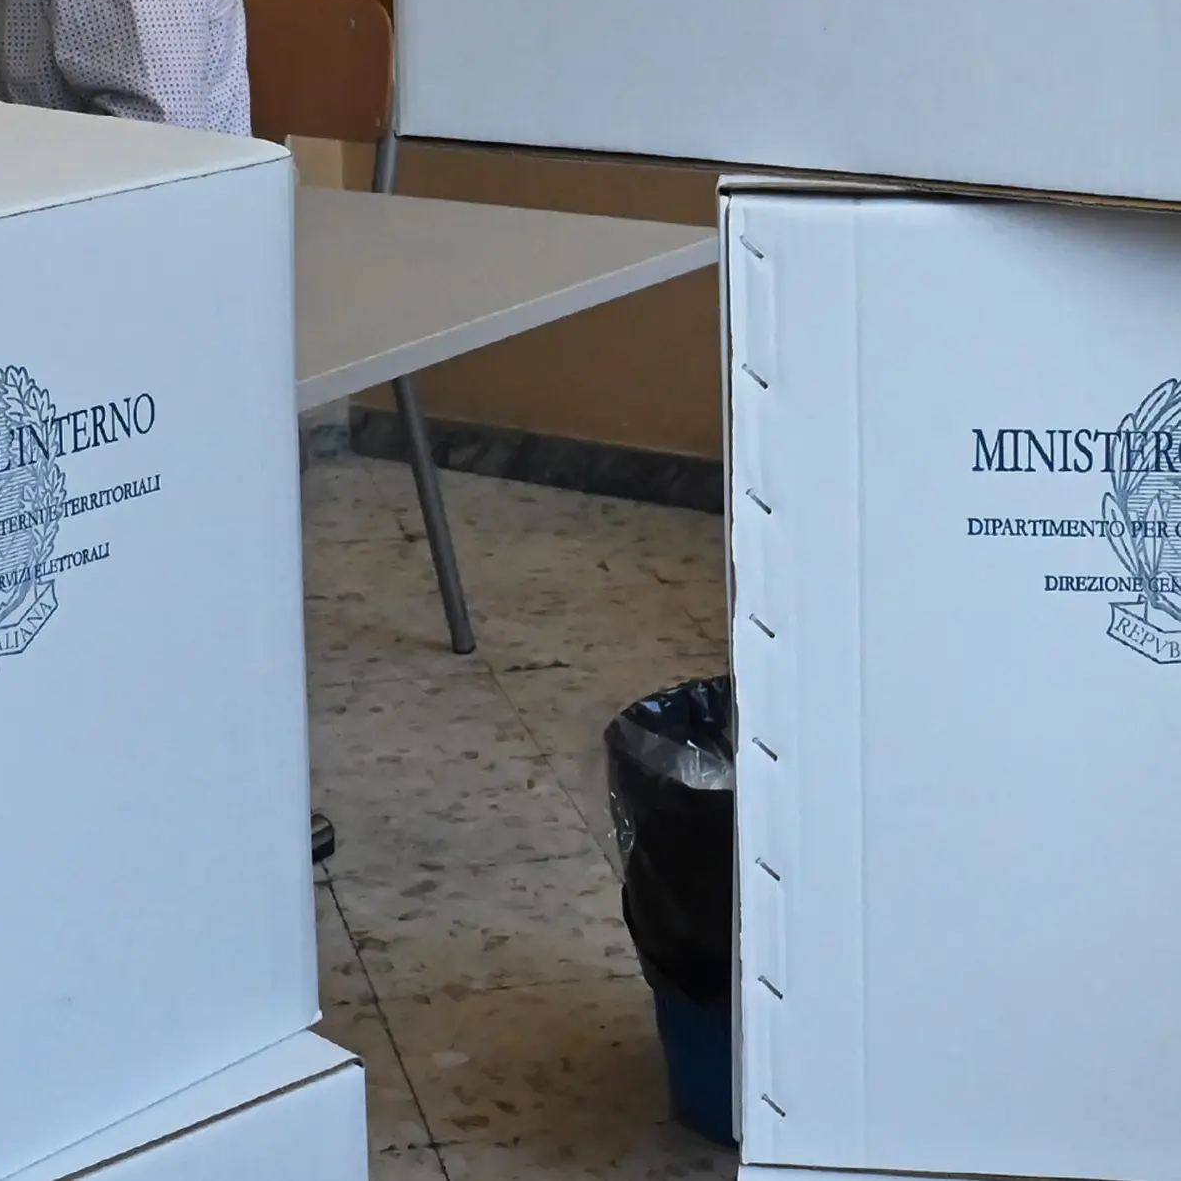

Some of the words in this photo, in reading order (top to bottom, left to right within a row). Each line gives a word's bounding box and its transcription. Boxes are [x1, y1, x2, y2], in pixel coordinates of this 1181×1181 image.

[971, 428, 1181, 474] MINISTER
[62, 474, 161, 519] TERRITORIALI
[966, 517, 1126, 538] DIPARTIMENTO
[1131, 519, 1170, 538] PER
[35, 542, 110, 578] ELETTORALI
[1044, 575, 1144, 593] DIREZIONE
